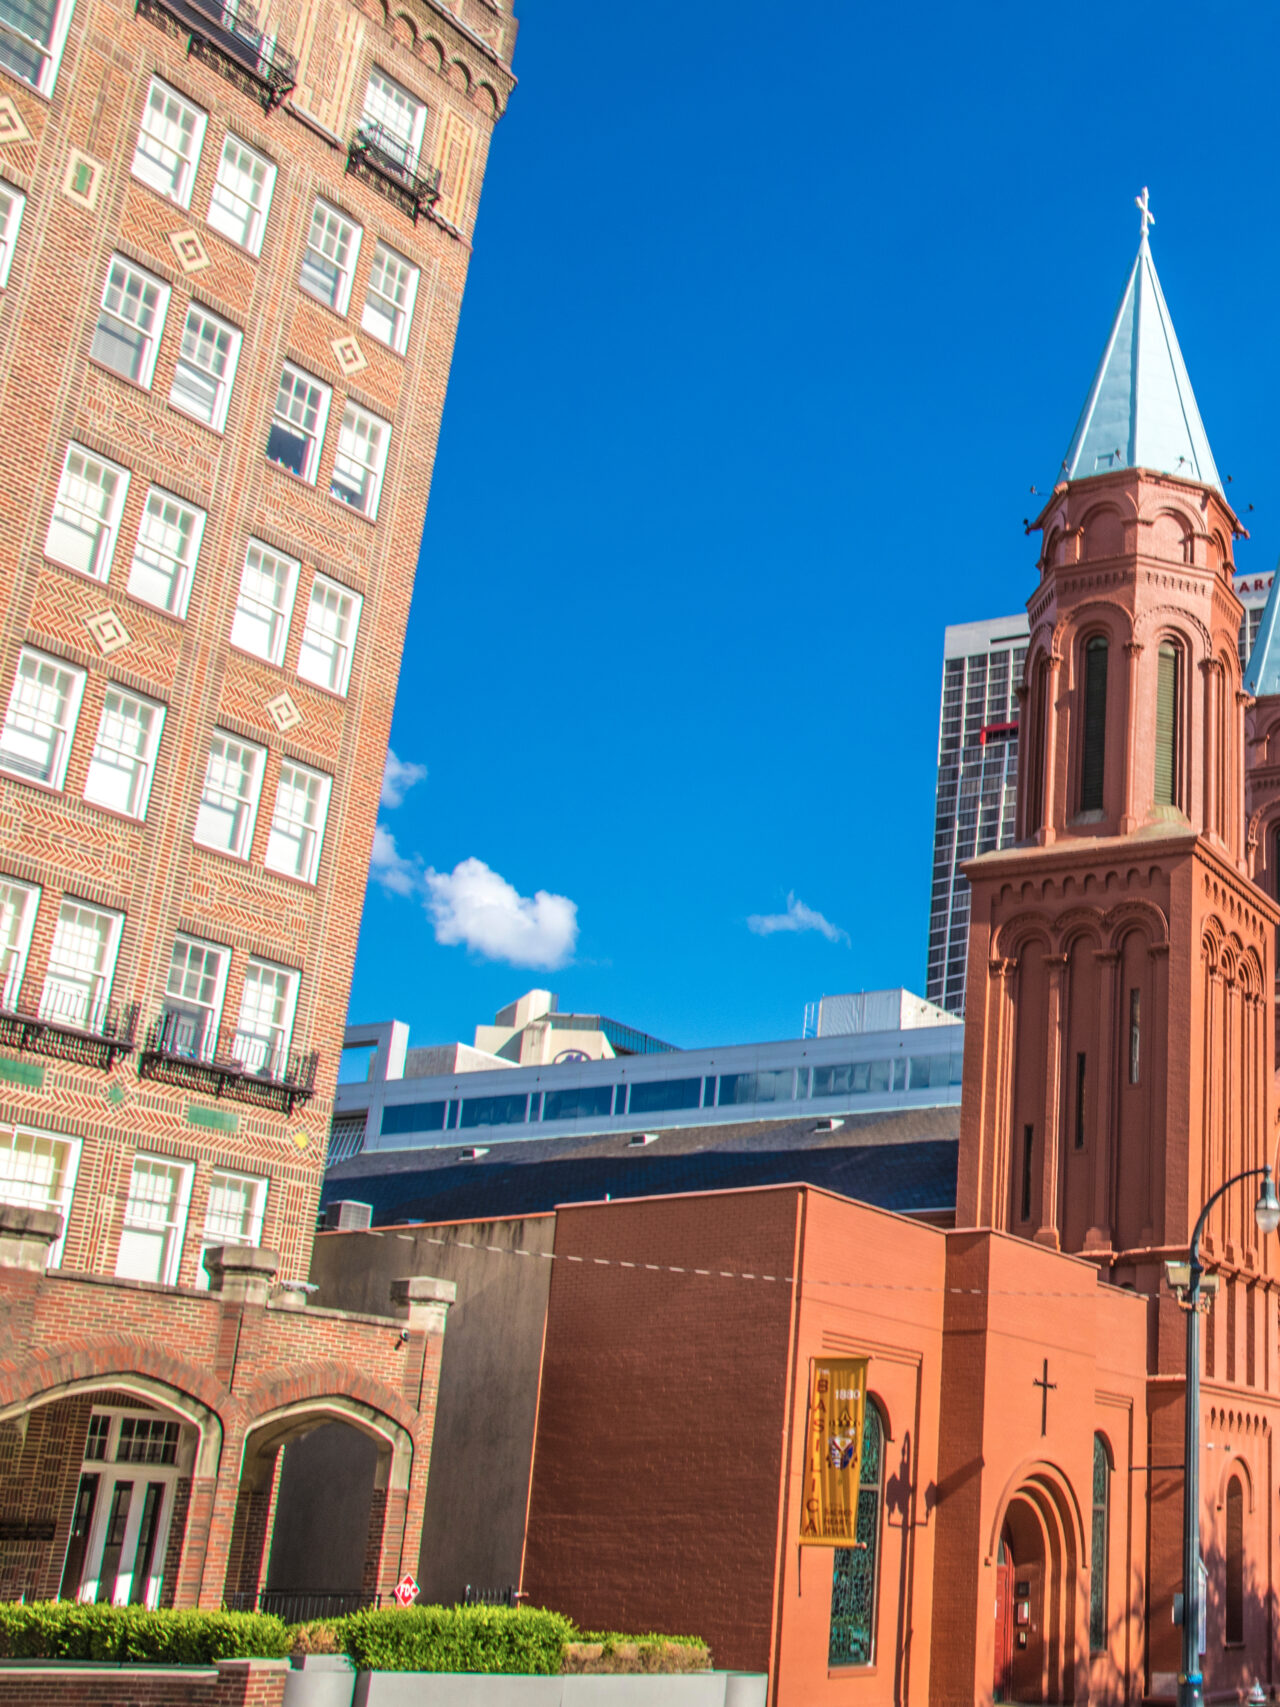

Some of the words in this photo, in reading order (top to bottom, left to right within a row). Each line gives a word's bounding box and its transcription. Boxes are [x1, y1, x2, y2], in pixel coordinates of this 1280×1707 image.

[835, 1388, 861, 1401] 1880
[804, 1379, 829, 1534] BASILICA
[400, 1583, 416, 1598] FDC
